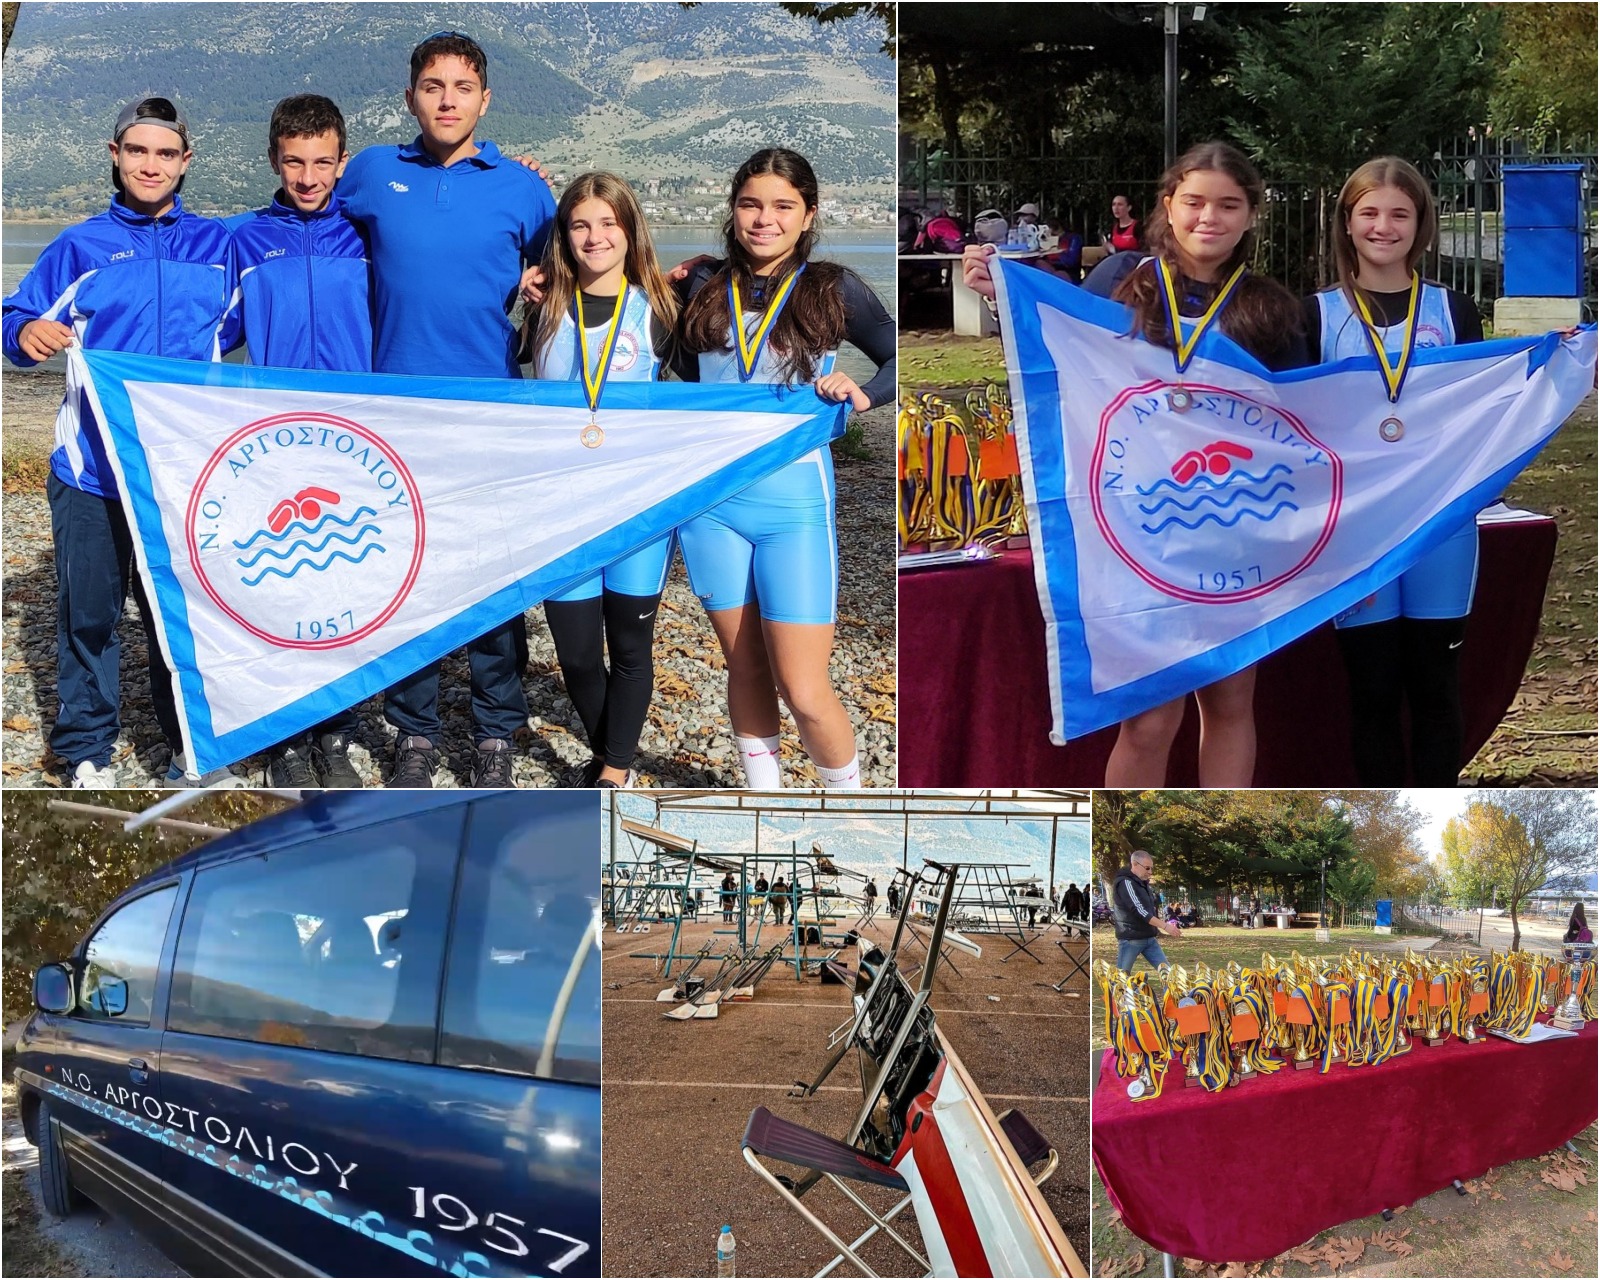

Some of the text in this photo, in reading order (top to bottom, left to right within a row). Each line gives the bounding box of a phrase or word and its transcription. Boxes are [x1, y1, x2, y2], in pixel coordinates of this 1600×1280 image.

[199, 426, 409, 551] Ν.Ο. ΑΡΓΟΣΤΟΛΙΟΥ
[1103, 436, 1129, 492] Ν.Ο.
[1197, 565, 1263, 592] 1957
[295, 609, 355, 640] 1957
[61, 1067, 590, 1275] Ν.Ο. ΑΡΓΟΣΤΟΛΙΟΥ 1957
